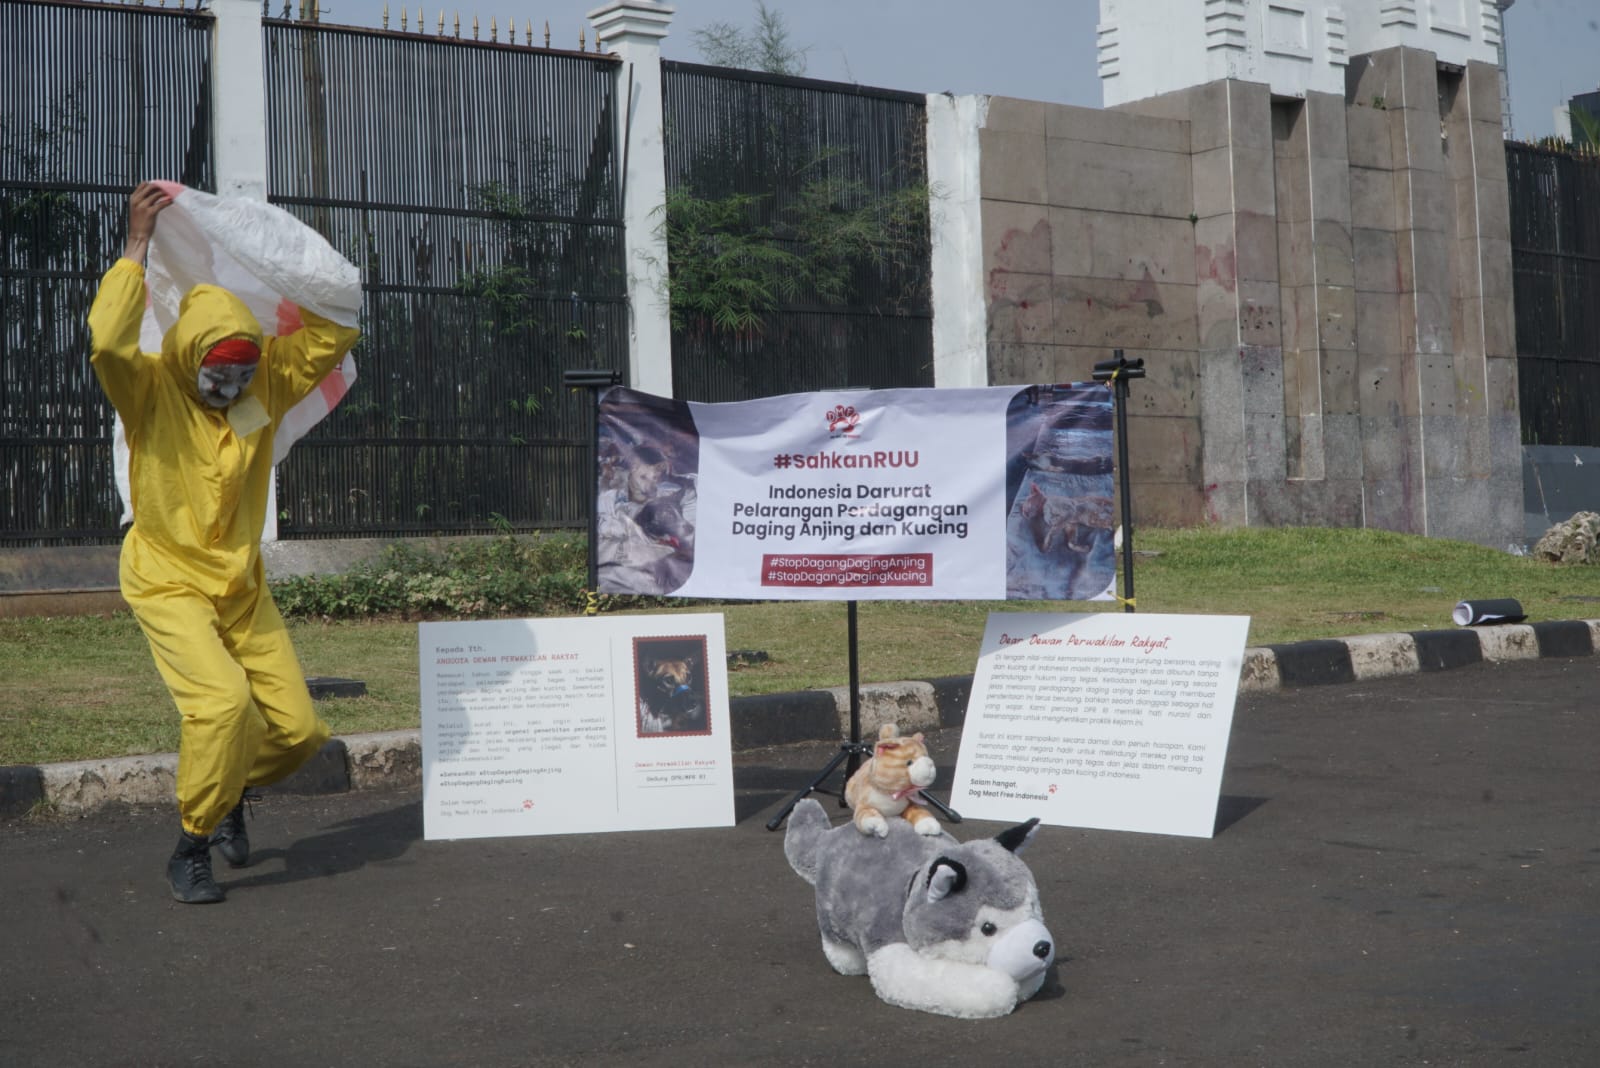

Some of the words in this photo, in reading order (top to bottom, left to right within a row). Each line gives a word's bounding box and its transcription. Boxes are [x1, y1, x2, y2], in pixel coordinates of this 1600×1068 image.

[774, 450, 919, 469] #SahkanRUU
[768, 483, 852, 499] Indonesia
[856, 484, 932, 499] Darurat
[734, 502, 832, 522] Pelarangan
[732, 521, 795, 540] Daging
[800, 521, 854, 540] Anjing
[860, 522, 896, 536] dan
[902, 520, 968, 539] Kucing
[770, 556, 925, 570] #StopDagangDagingAnjing
[768, 570, 926, 584] #StopDagangDagingKucing
[1000, 633, 1024, 646] Dear
[1029, 634, 1062, 646] Dewan
[1067, 633, 1126, 646] Perwakilan
[971, 778, 991, 786] Salam
[969, 788, 981, 797] Dog
[1015, 791, 1049, 800] Indonesia
